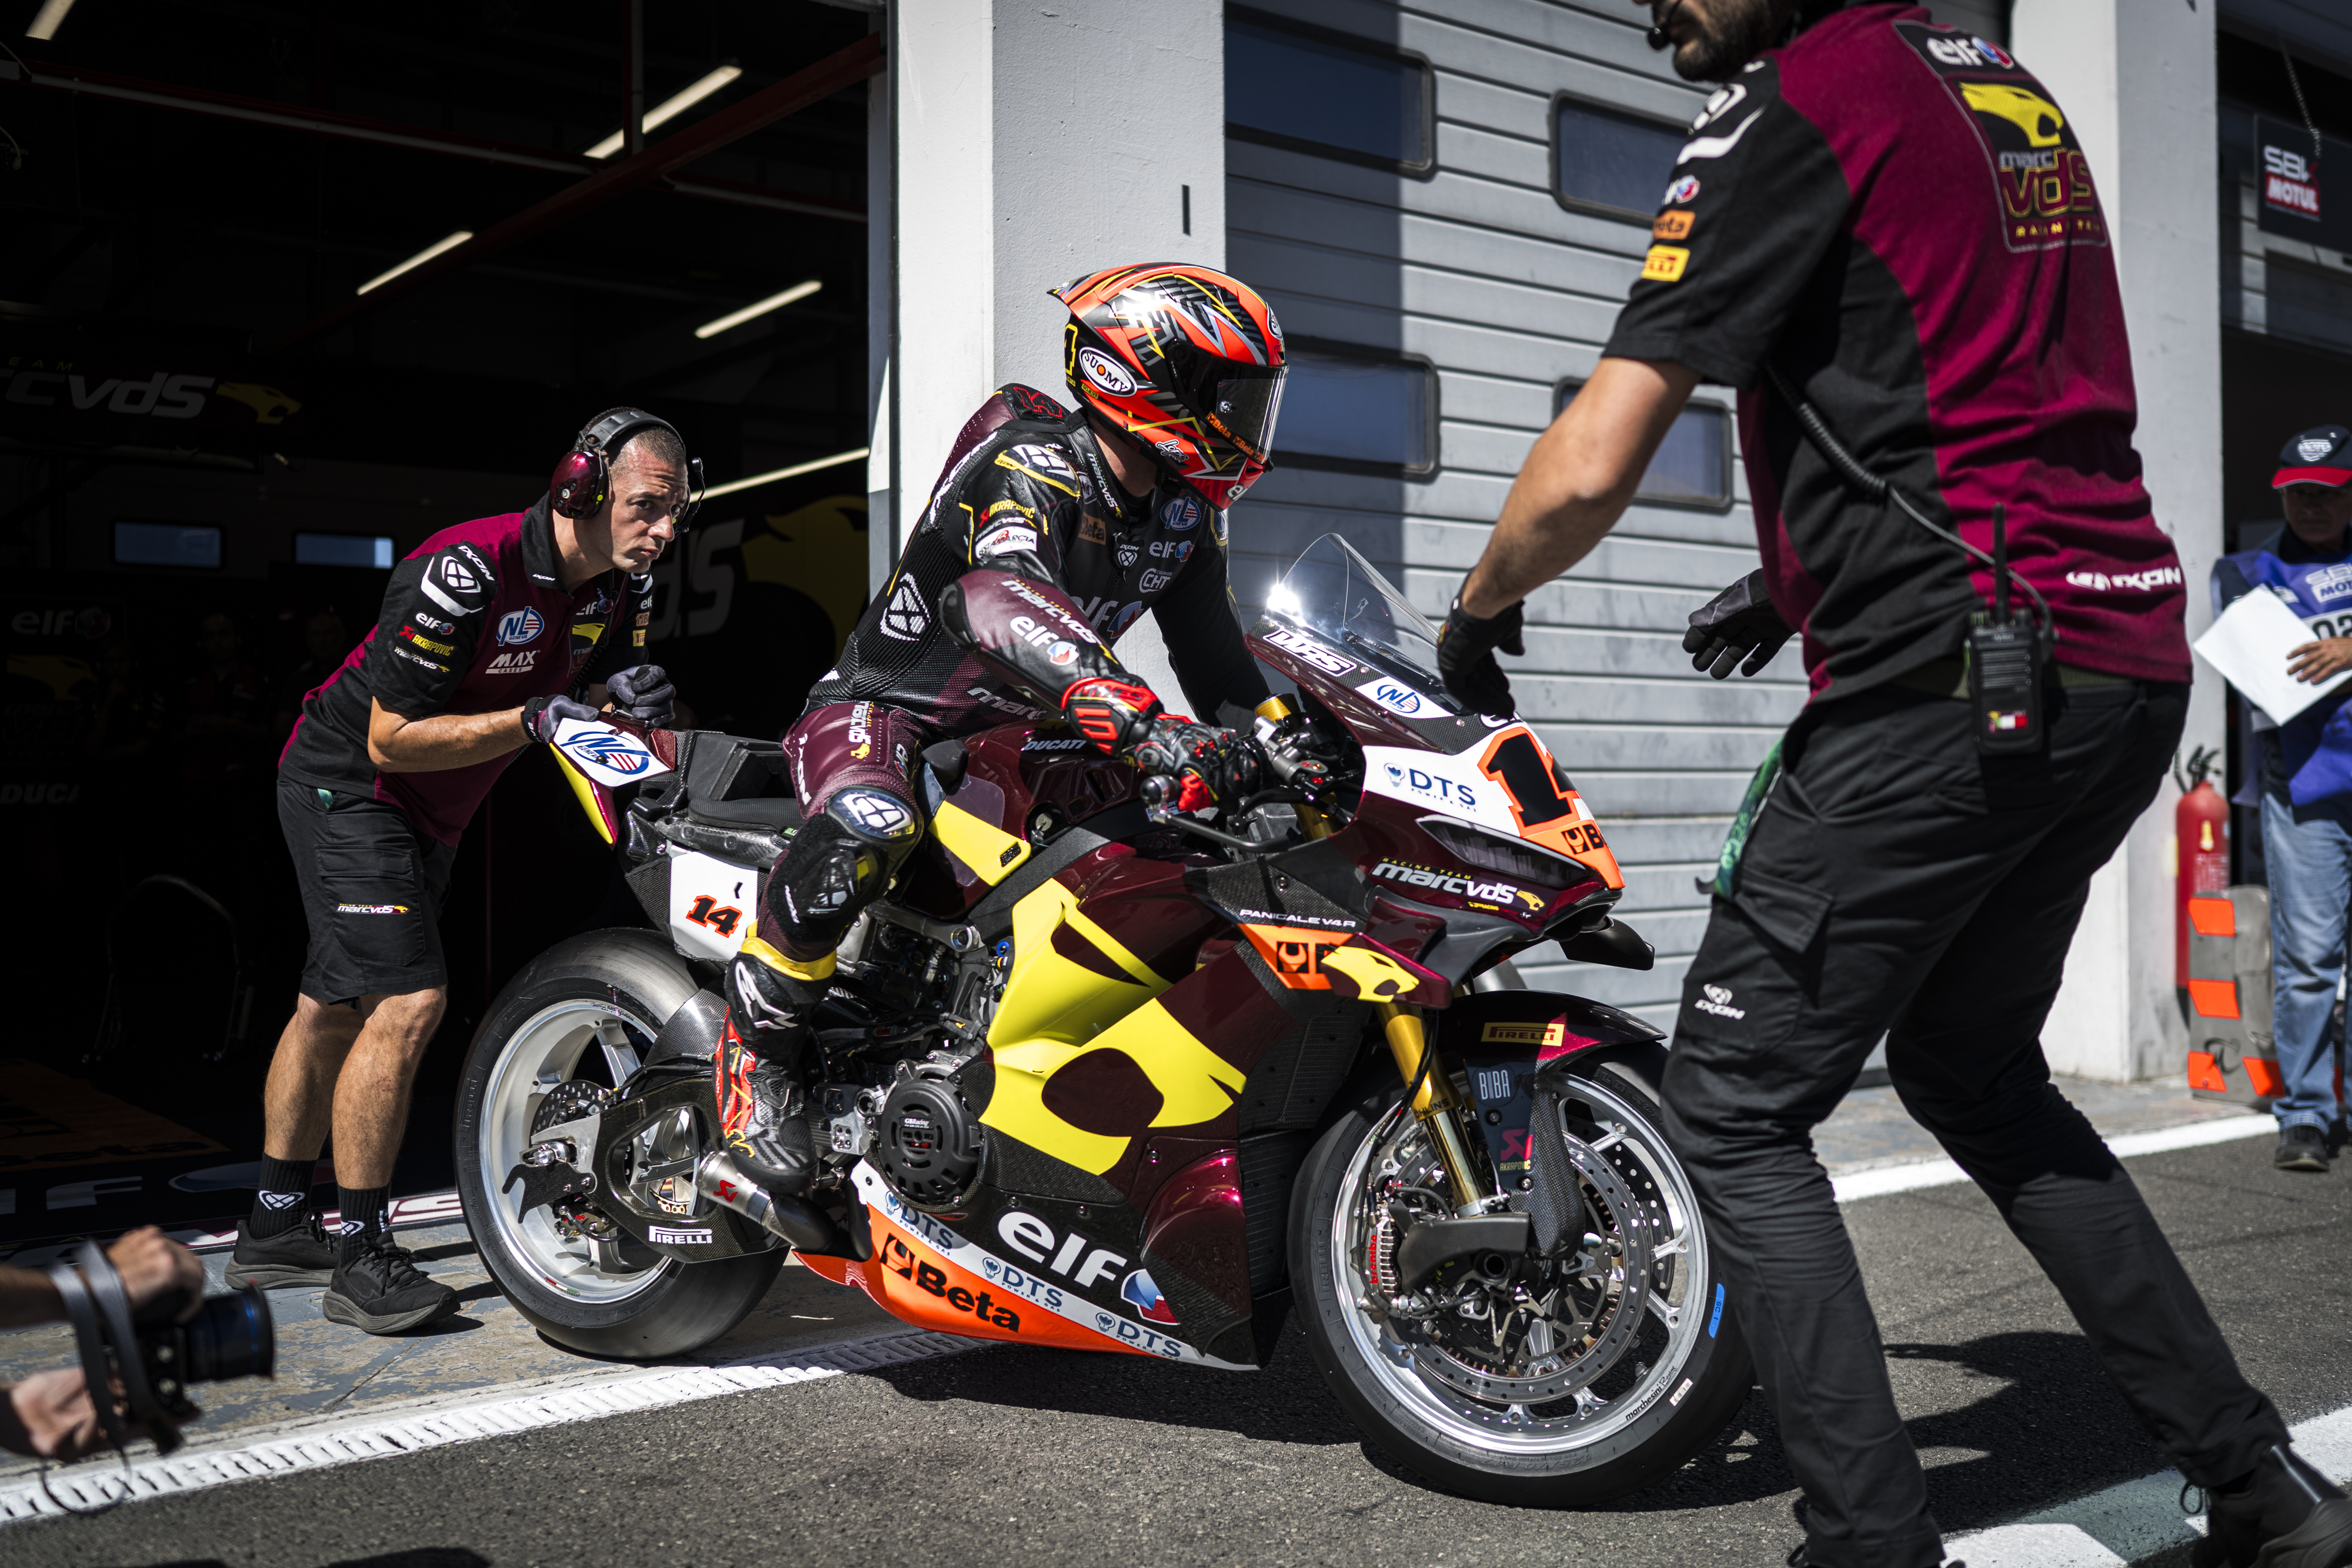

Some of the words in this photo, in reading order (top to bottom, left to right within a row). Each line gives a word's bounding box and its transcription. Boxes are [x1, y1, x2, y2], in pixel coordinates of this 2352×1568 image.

[2264, 145, 2319, 186] SBK
[2267, 176, 2318, 211] MOTUL
[1084, 350, 1128, 393] SUOMY
[1083, 385, 1098, 398] BELIEVE
[1212, 418, 1231, 438] Beta
[1238, 439, 1254, 455] Beta
[458, 545, 495, 581] IXON
[1149, 541, 1176, 558] elf
[11, 609, 75, 636] elf
[415, 612, 441, 629] elf
[1010, 616, 1060, 647] elf
[1268, 631, 1351, 671] WRS
[577, 745, 599, 759] GENEV
[1024, 739, 1087, 751] DUCATI
[1409, 768, 1476, 806] DTS
[1372, 862, 1518, 904] marcvds
[1382, 858, 1431, 871] RACING
[1439, 869, 1471, 880] TEAM
[686, 894, 743, 938] 14
[1488, 1025, 1556, 1041] PIRELLI
[904, 1118, 930, 1126] GBRacing
[649, 1225, 713, 1244] PIRELLI
[899, 1219, 925, 1239] POWER
[936, 1245, 951, 1256] GAS
[901, 1206, 954, 1250] DTS
[998, 1211, 1127, 1287] elf
[1368, 1235, 1379, 1285] brembo
[917, 1259, 1021, 1333] Beta
[1001, 1282, 1031, 1299] POWER
[1044, 1302, 1061, 1313] GAS
[1003, 1266, 1064, 1308] DTS
[1715, 1300, 1722, 1313] SC
[1116, 1335, 1147, 1350] POWER
[1117, 1320, 1182, 1358] DTS
[1625, 1383, 1663, 1422] marchesini
